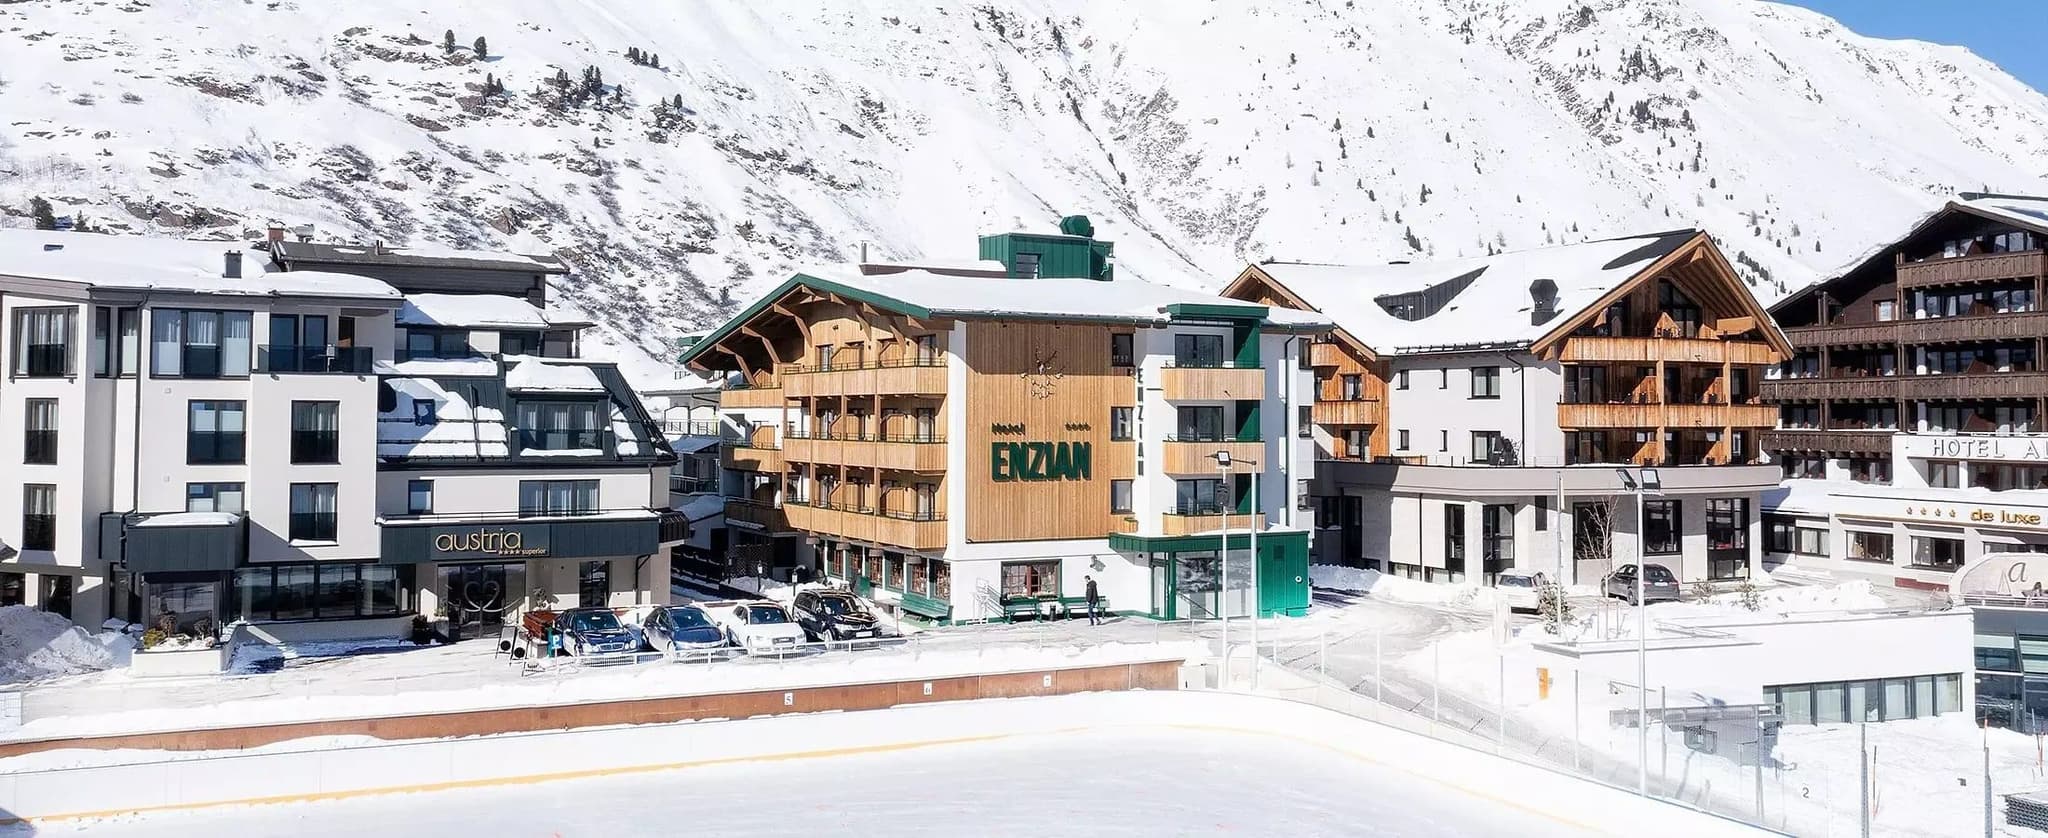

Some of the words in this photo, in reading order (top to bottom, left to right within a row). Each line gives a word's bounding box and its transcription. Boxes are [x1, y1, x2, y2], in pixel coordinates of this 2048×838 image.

[991, 421, 1026, 436] Hotel
[1137, 367, 1145, 477] ENZIAN
[1932, 438, 2006, 459] HOTEL
[2023, 439, 2048, 460] A
[991, 441, 1093, 483] ENZIAN
[1970, 508, 1994, 523] de
[2001, 509, 2041, 526] luxe
[435, 527, 521, 553] austria
[521, 547, 546, 556] superior
